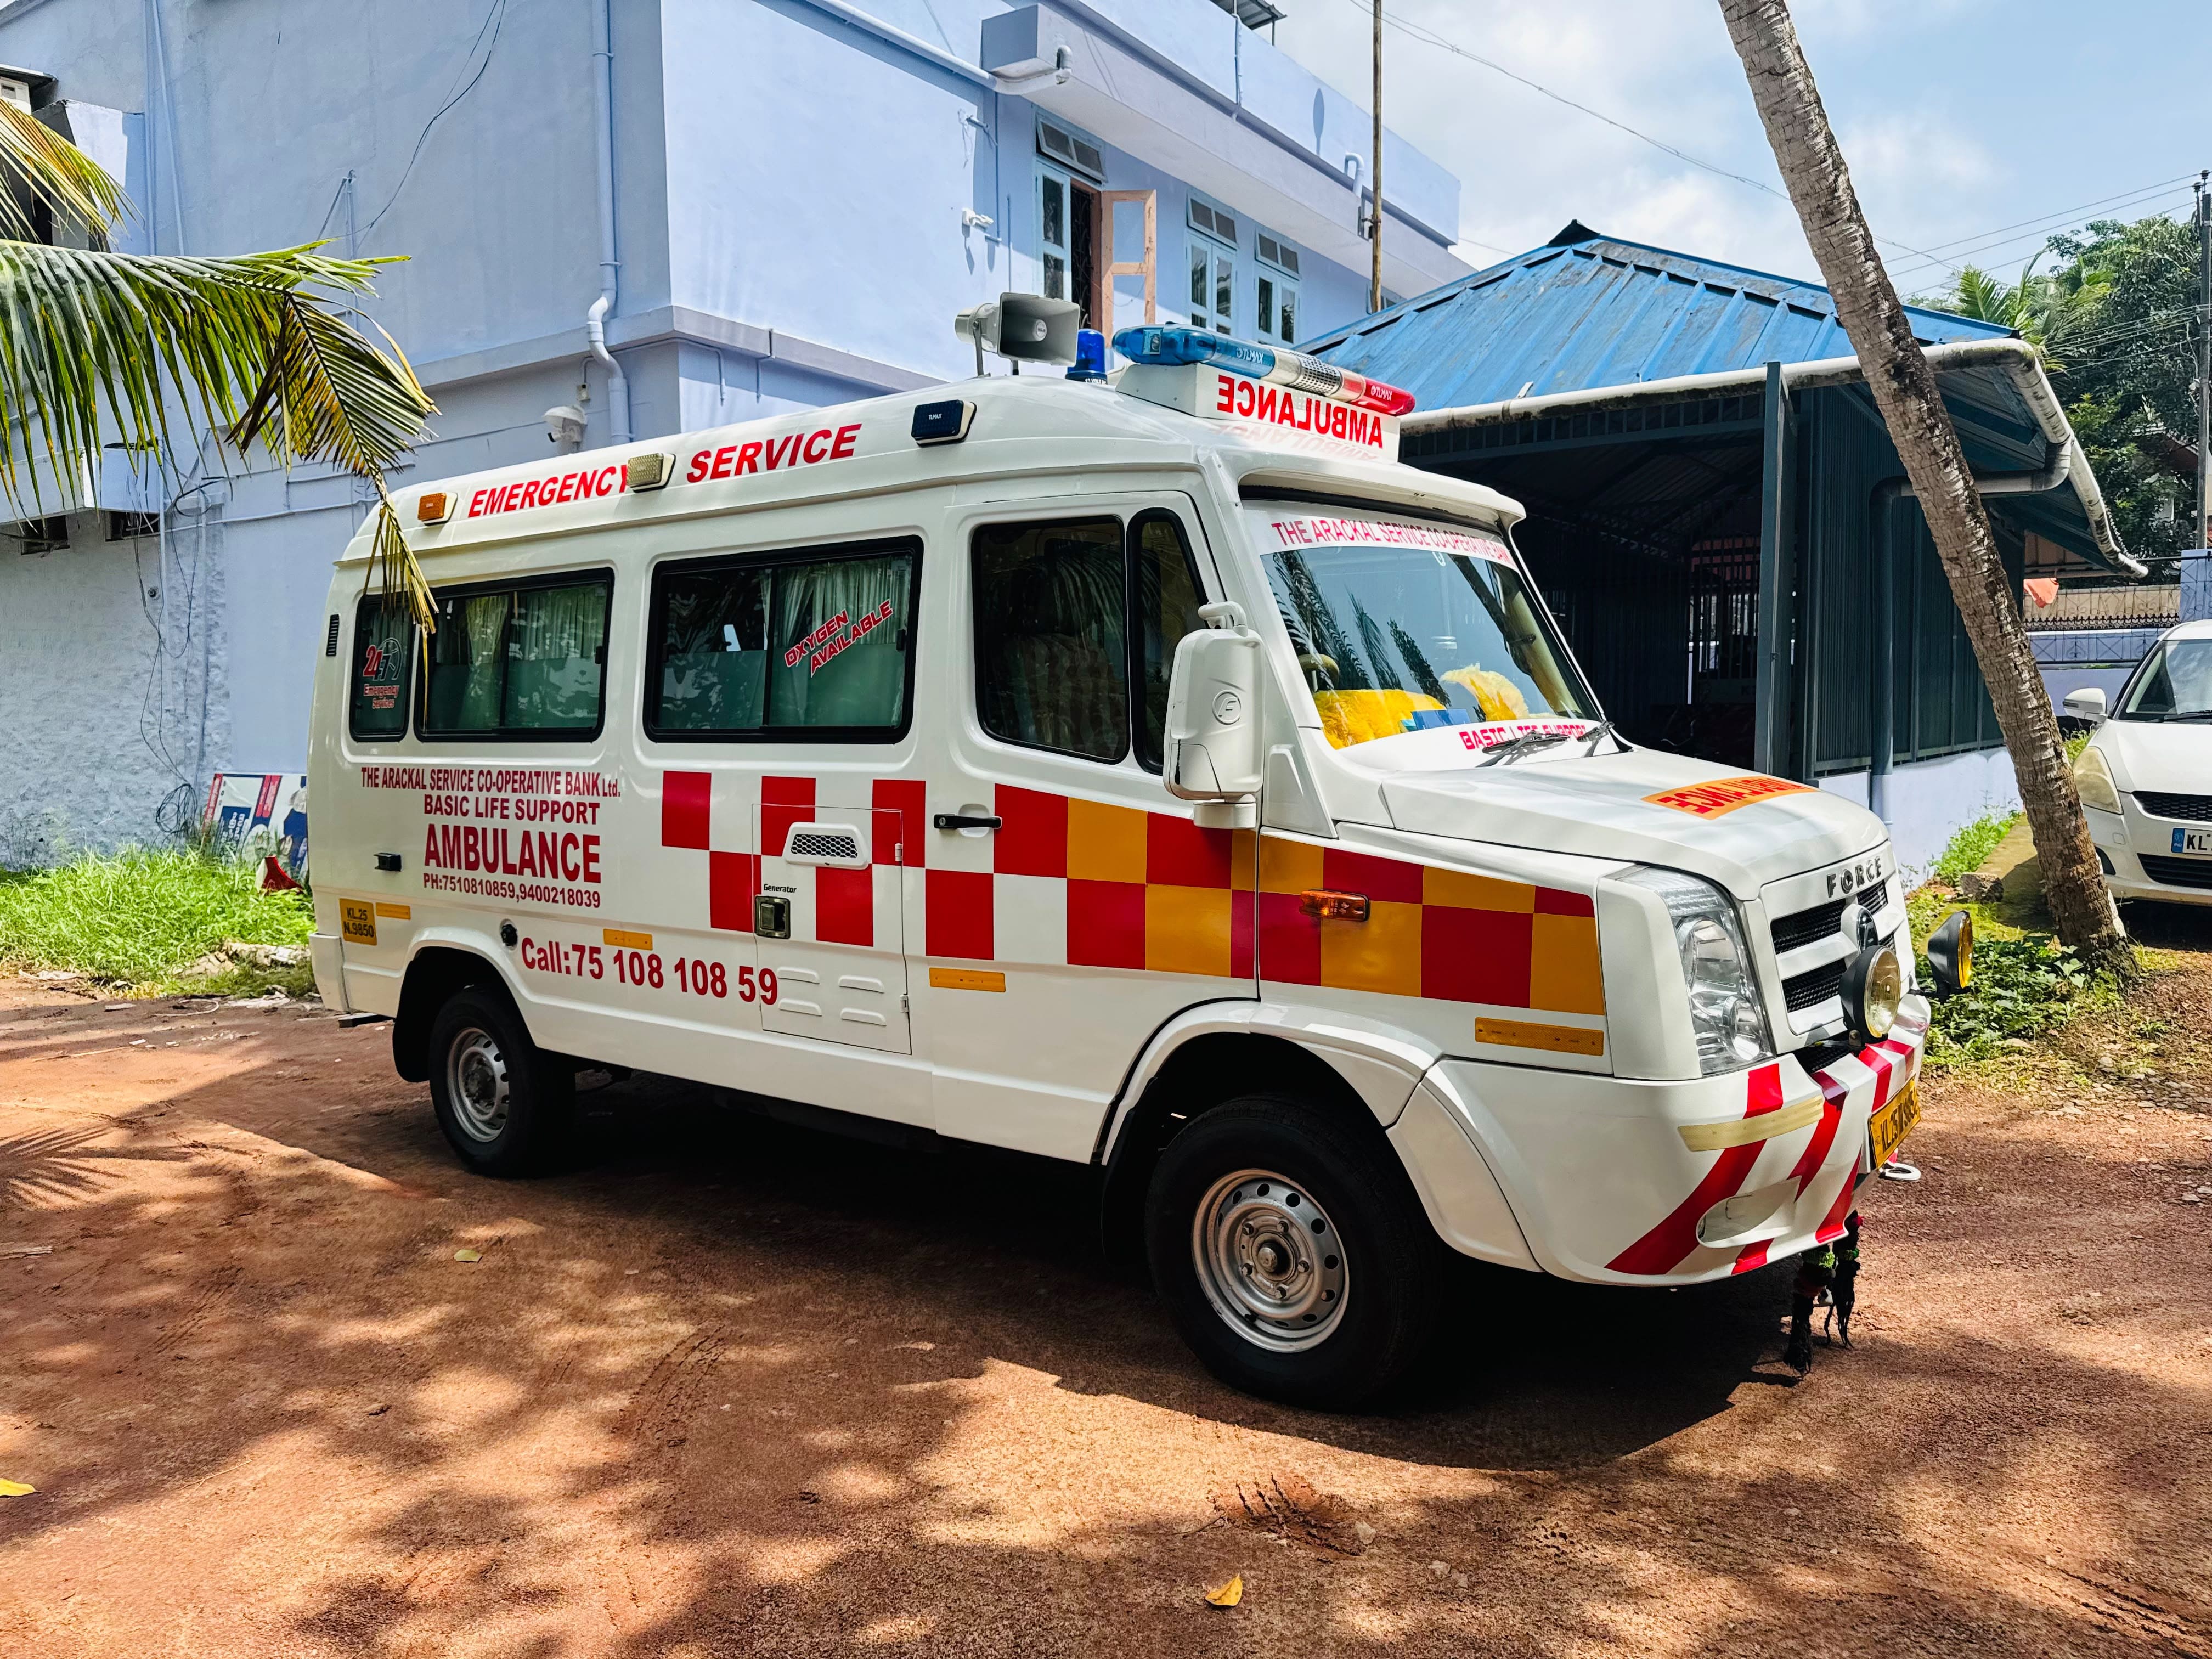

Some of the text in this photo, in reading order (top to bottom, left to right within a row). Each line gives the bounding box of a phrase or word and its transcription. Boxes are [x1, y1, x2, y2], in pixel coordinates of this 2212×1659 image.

[686, 423, 861, 483] SERVICE
[1271, 521, 1313, 546] THE
[1311, 519, 1382, 542] ARACKAL
[1376, 521, 1431, 546] SERVICE
[785, 608, 849, 668] OXYGEN
[810, 599, 893, 678] AVAILABLE
[364, 684, 399, 698] Emergency
[1459, 727, 1508, 750] BASIC
[361, 767, 622, 798] THE ARACKAL SERVICE CO-OPERATIVE BANK Ltd.
[424, 794, 601, 825] BASIC LIFE SUPPORT
[425, 823, 602, 884] AMBULANCE
[423, 873, 601, 909] PH:7510810859,9400218039
[764, 883, 797, 894] Generator
[1826, 856, 1882, 899] FORCE
[521, 938, 778, 1006] Call:75 108 108 59
